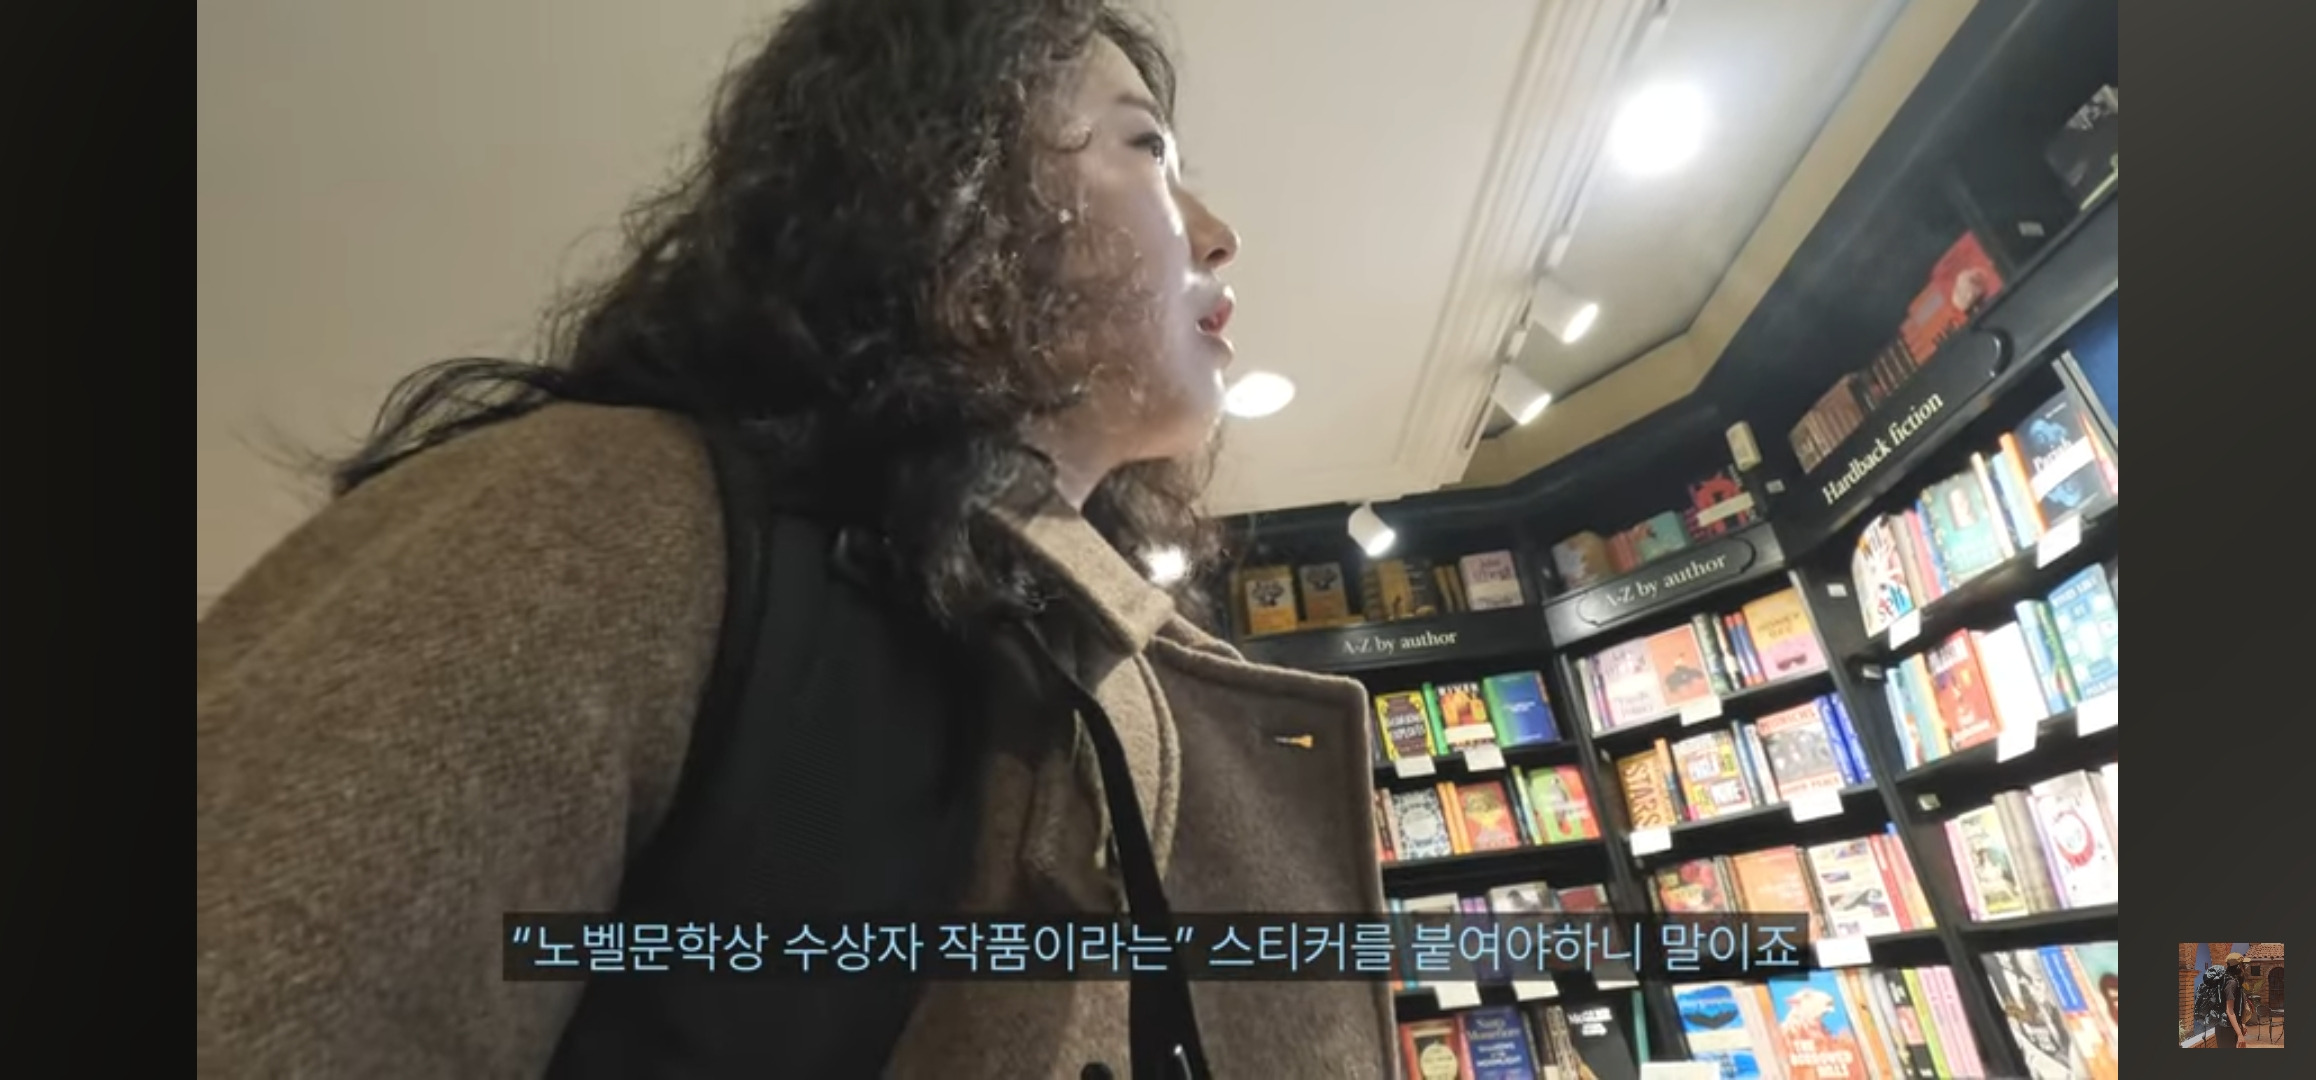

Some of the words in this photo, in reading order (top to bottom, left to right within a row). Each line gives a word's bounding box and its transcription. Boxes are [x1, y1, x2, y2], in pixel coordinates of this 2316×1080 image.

[1821, 438, 1892, 505] Hardback
[1888, 393, 1944, 446] fiction
[1604, 586, 1636, 607] A-Z
[1635, 581, 1658, 599] by
[1663, 554, 1727, 589] author
[1342, 637, 1373, 655] A-Z
[1374, 636, 1395, 655] by
[1400, 630, 1458, 649] author
